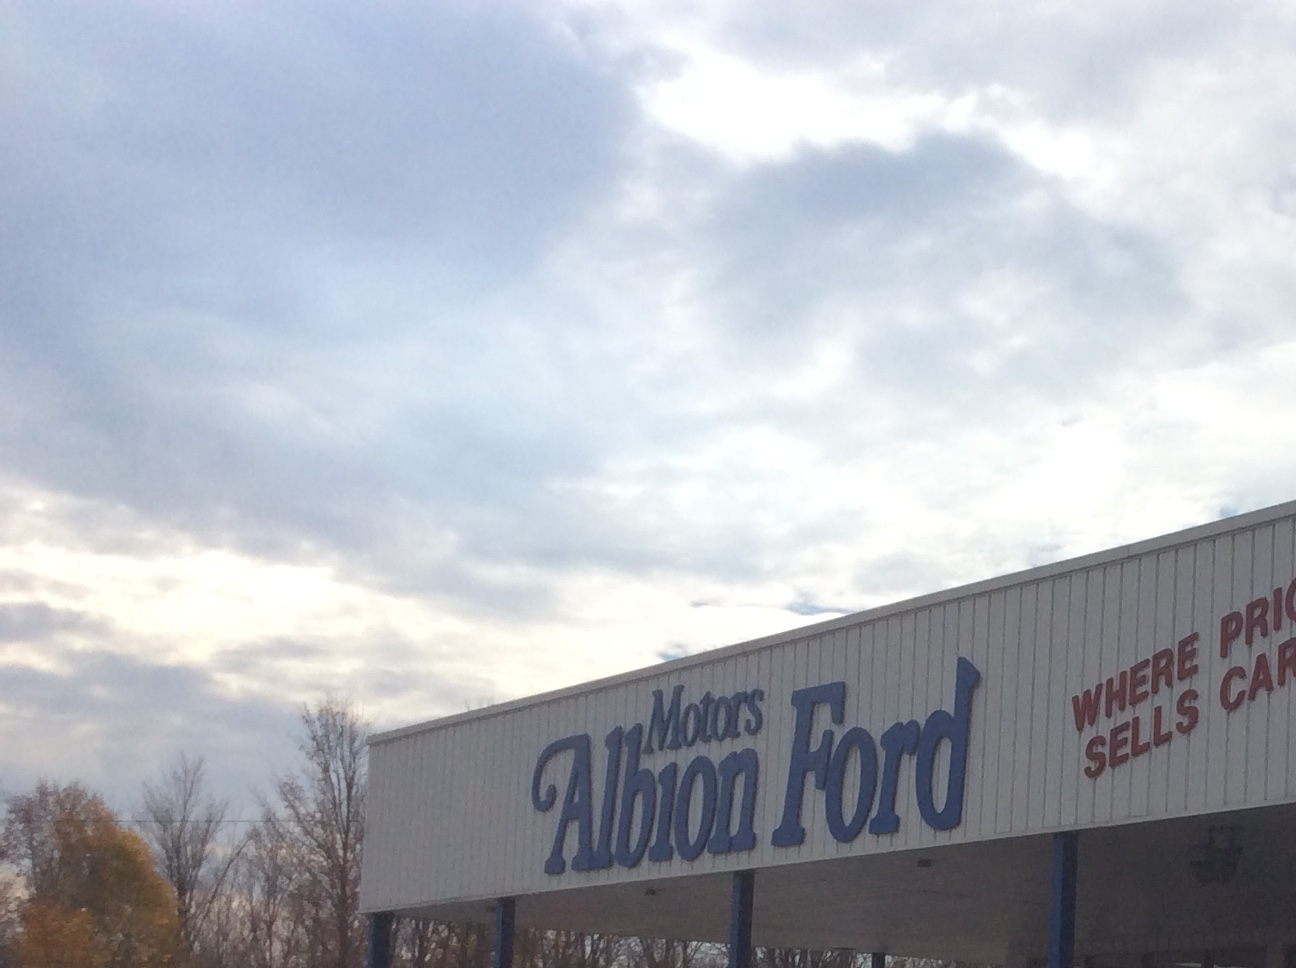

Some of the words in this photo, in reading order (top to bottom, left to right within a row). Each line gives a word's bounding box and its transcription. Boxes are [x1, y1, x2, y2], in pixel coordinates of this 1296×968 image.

[643, 684, 764, 754] Motors
[1072, 632, 1199, 731] WHERE
[531, 722, 759, 875] Albion
[771, 656, 980, 846] Ford
[1084, 689, 1199, 778] SELLS
